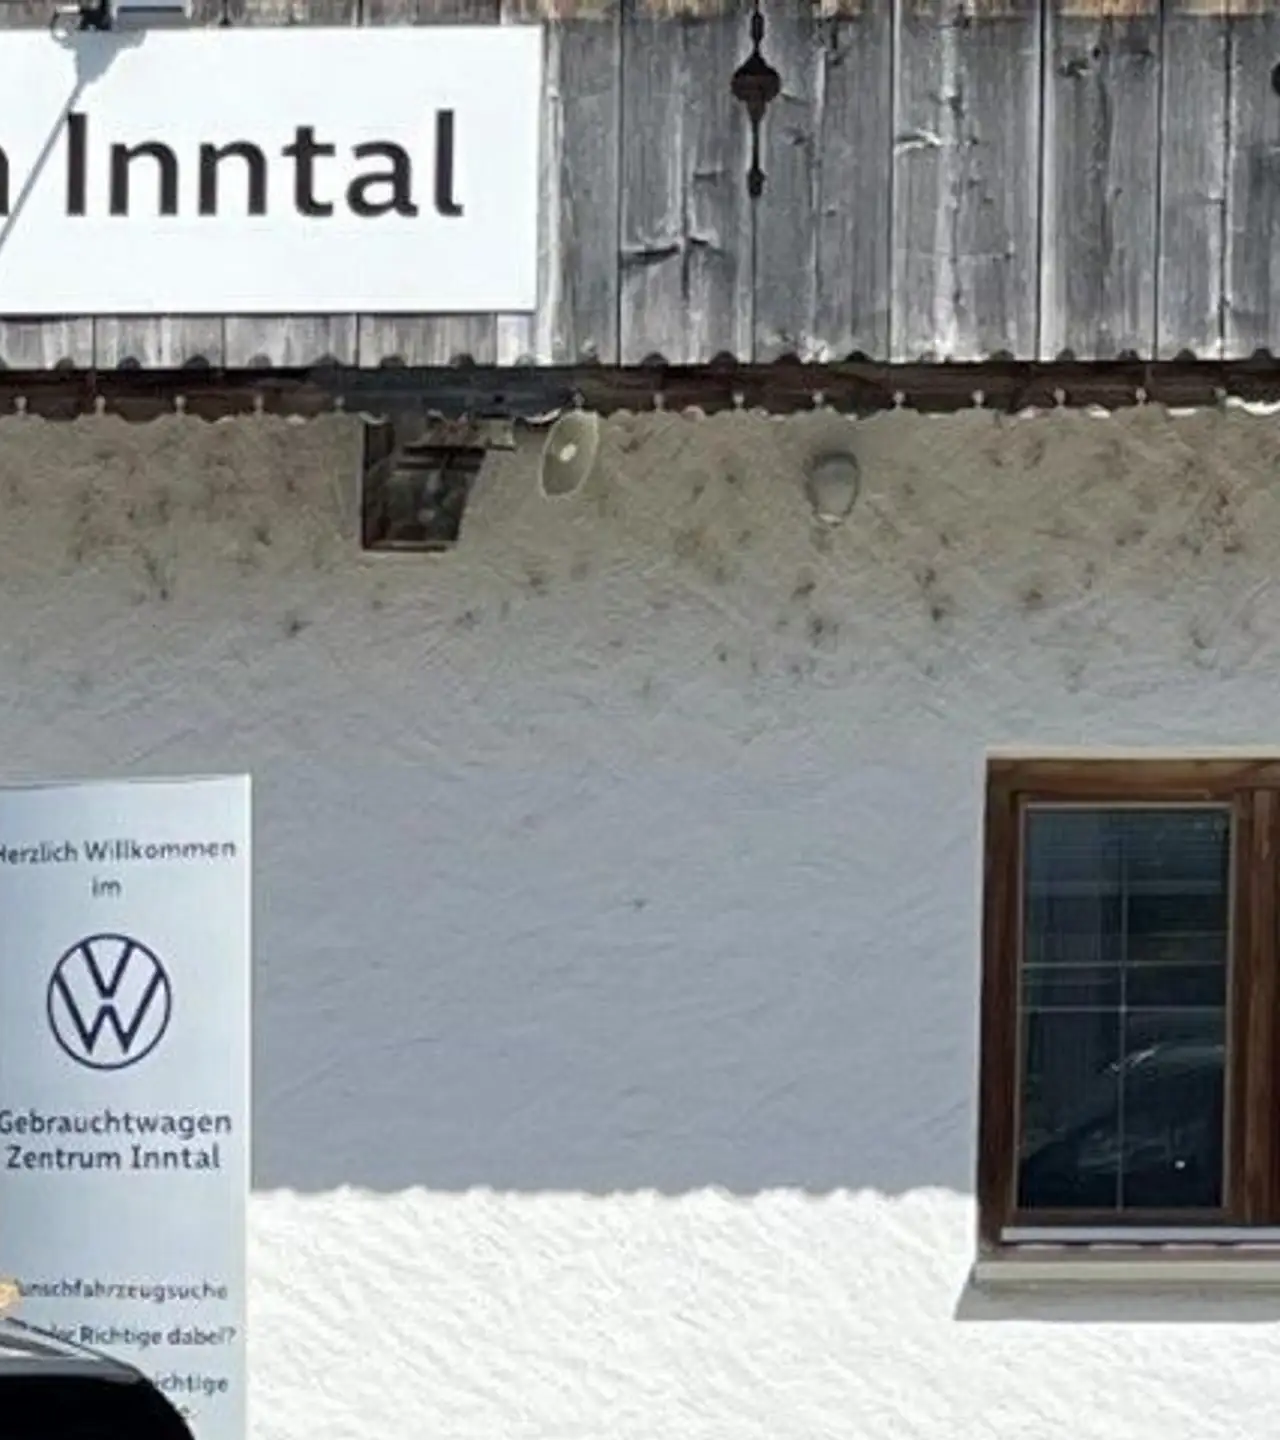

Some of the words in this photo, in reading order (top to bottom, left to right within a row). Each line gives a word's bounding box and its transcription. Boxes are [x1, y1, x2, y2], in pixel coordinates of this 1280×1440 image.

[65, 109, 464, 217] Inntal
[86, 840, 237, 864] Willkommen
[92, 879, 122, 897] im
[6, 1144, 121, 1171] Zentrum
[132, 1144, 221, 1170] Inntal
[12, 1279, 228, 1303] unschfahrzeugsuche
[154, 1372, 229, 1396] ichtige
